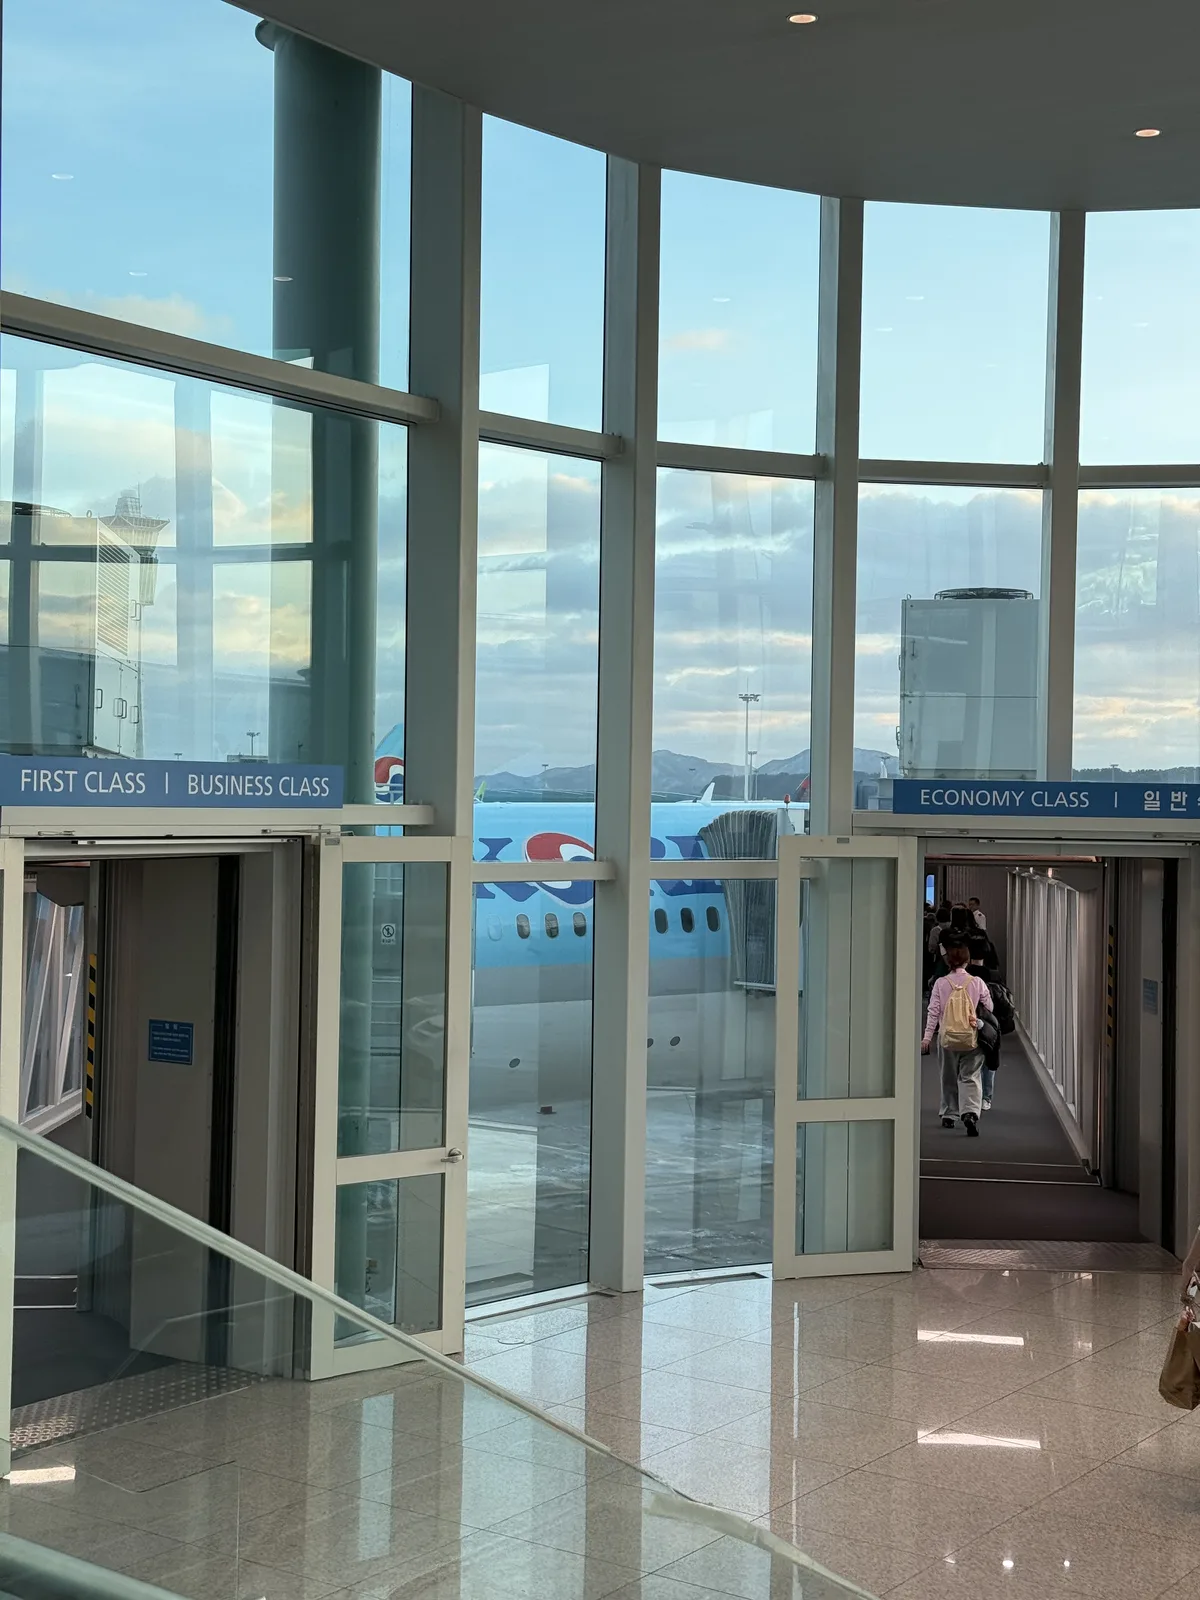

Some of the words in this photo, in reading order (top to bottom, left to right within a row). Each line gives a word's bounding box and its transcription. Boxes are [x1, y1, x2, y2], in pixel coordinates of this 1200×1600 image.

[20, 769, 78, 793] FIRST
[84, 771, 146, 794] CLASS
[187, 774, 273, 797] BUSINESS
[278, 776, 330, 798] CLASS
[919, 788, 1025, 808] ECONOMY
[1030, 791, 1090, 809] CLASS
[1143, 790, 1200, 813] 일반
